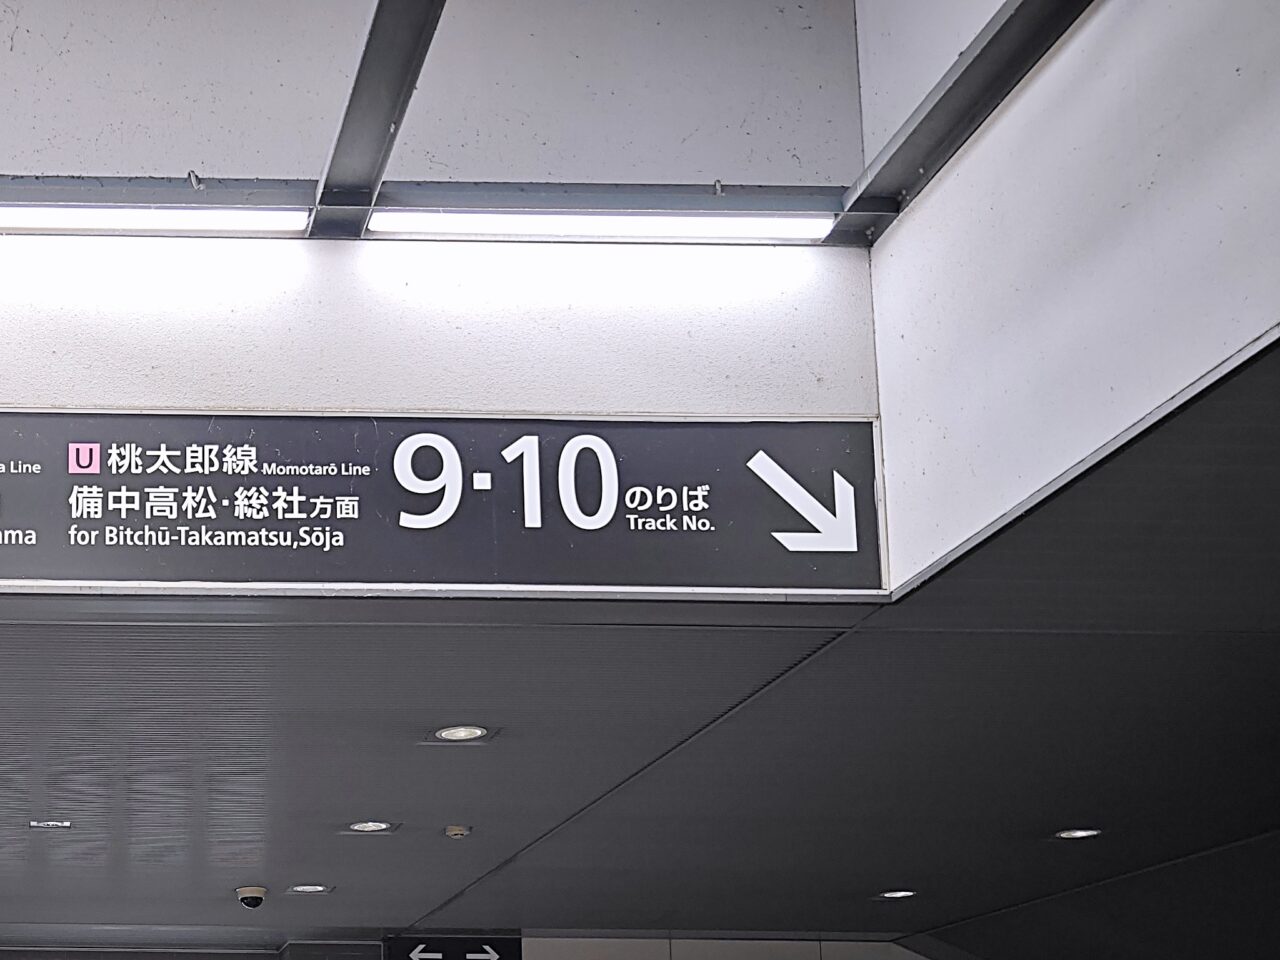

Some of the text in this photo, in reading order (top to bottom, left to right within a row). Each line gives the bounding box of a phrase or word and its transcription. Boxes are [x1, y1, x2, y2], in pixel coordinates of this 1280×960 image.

[10, 460, 41, 474] Line
[76, 448, 94, 469] U
[107, 443, 371, 477] 桃太郎線 Momotarō Line
[625, 485, 710, 512] のりば
[626, 515, 716, 531] Track No.
[68, 526, 100, 547] for
